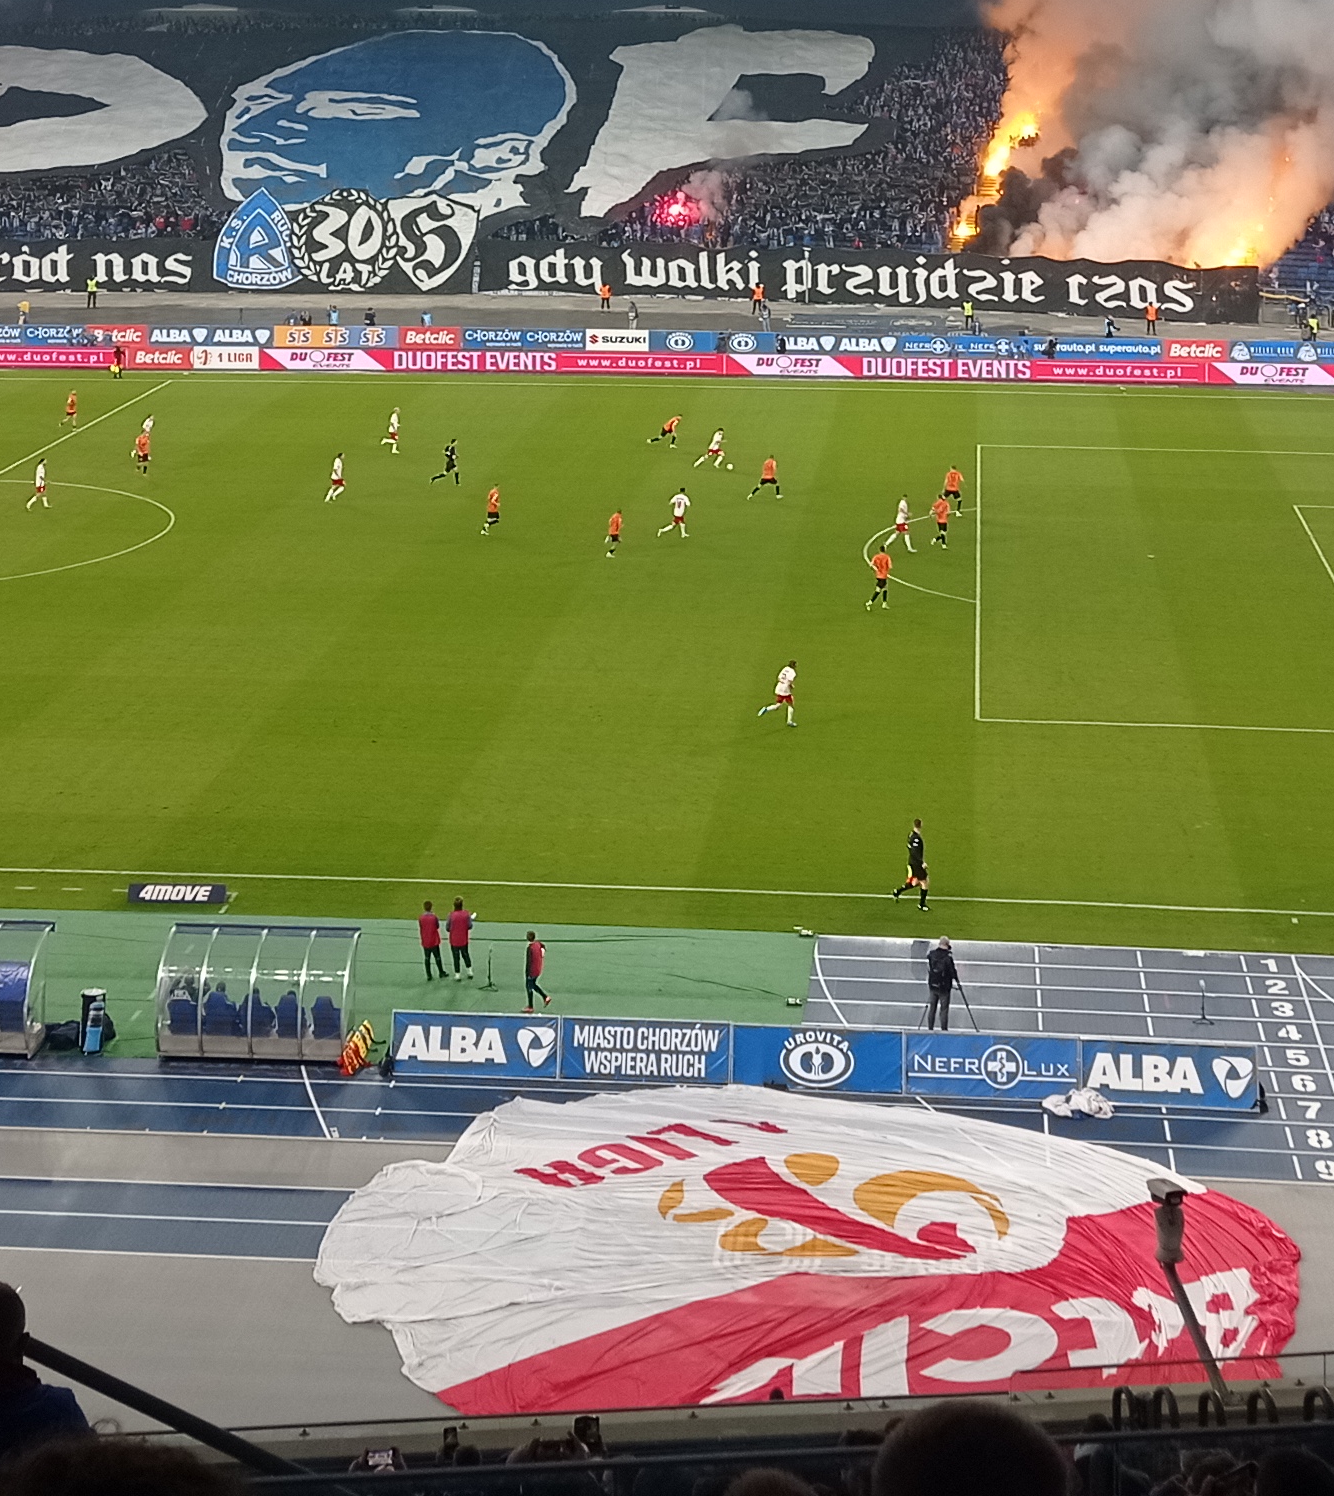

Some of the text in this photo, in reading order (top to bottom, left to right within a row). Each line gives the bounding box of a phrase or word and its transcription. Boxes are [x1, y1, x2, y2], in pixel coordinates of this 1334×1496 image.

[270, 210, 294, 247] RUC
[311, 204, 383, 261] 30
[90, 252, 193, 284] nas
[320, 261, 375, 287] LAT
[226, 269, 293, 284] CHORZÓW
[507, 247, 604, 294] gdy
[621, 249, 761, 291] walki
[781, 255, 1045, 304] przyjdzie
[1065, 273, 1196, 313] czas
[94, 328, 142, 342] Btclic
[150, 329, 191, 342] ALBA
[213, 329, 254, 342] ALBA
[286, 327, 385, 344] STS STS STS
[405, 330, 455, 344] Betclic
[465, 329, 521, 342] CHORZÓW
[526, 330, 583, 343] CHORZÓW
[601, 336, 647, 345] SUZUKI
[783, 337, 819, 351] LBA
[839, 338, 881, 352] ALBA
[1034, 343, 1096, 354] surauto.pl
[1099, 344, 1161, 356] superauto.pl
[1170, 344, 1222, 358] Betclic
[135, 351, 183, 364] Betclic
[227, 352, 253, 363] LIGA
[393, 352, 557, 372] DUOFEST EVENTS
[577, 357, 701, 370] www.duofest.pl
[862, 358, 1031, 379] DUOFEST EVENTS
[1052, 365, 1182, 379] www.duofest.pl
[139, 884, 213, 902] 4MOVE
[1260, 959, 1278, 972] 1
[1265, 979, 1289, 994] 2
[1270, 1001, 1295, 1017] 3
[572, 1022, 719, 1053] MIASTO CHORZÓW
[1277, 1024, 1302, 1040] 4
[395, 1024, 507, 1064] ALBA
[784, 1030, 850, 1052] UROVITA
[583, 1050, 707, 1078] WSPIERA RUCH
[1285, 1049, 1310, 1066] 5
[1085, 1051, 1205, 1094] ALBA
[1291, 1074, 1316, 1092] 6
[1296, 1101, 1322, 1119] 7
[1305, 1129, 1333, 1149] 8
